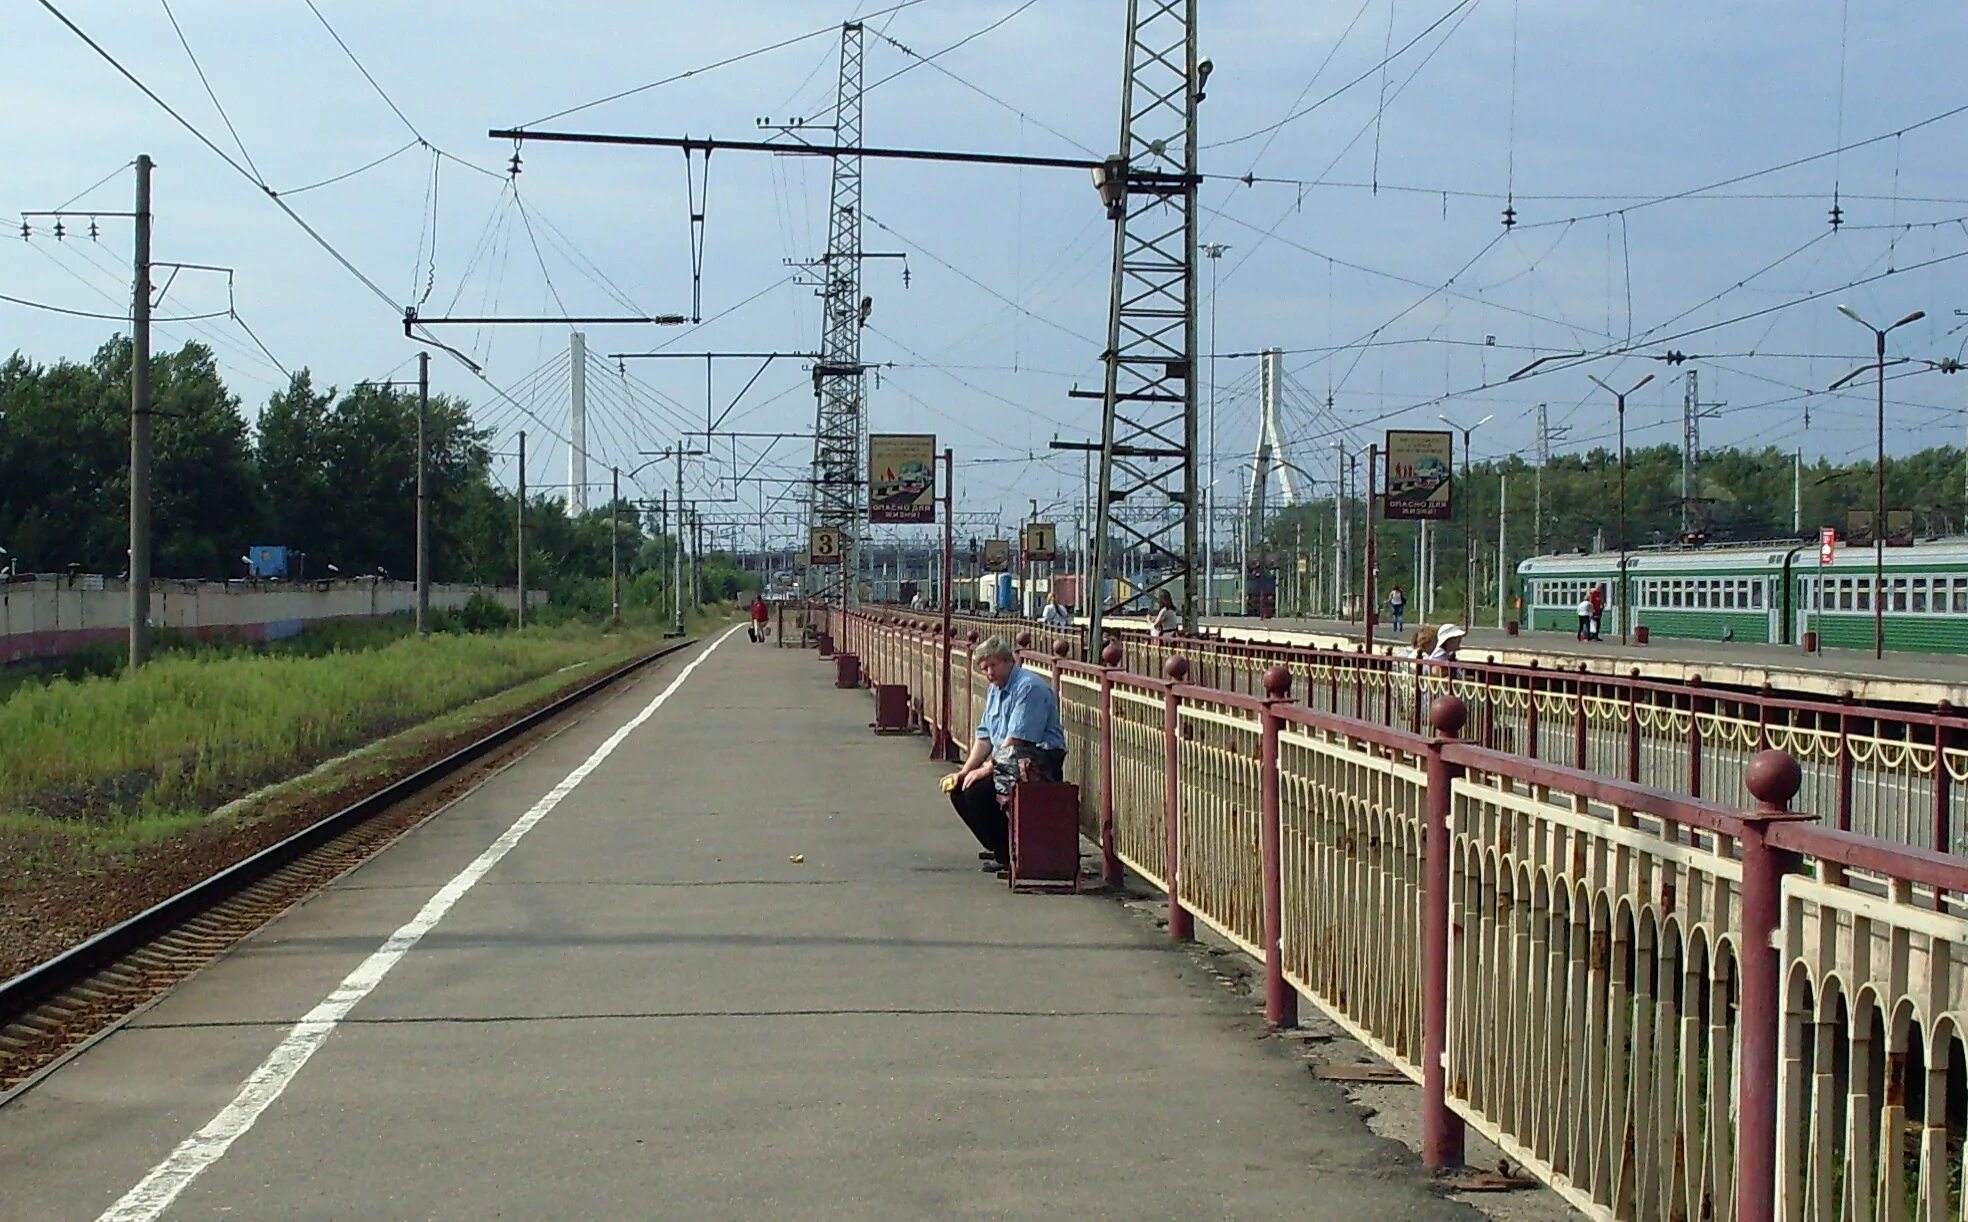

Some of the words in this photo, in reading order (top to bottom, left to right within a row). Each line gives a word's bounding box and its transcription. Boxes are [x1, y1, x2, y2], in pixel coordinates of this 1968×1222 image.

[911, 504, 931, 512] ДЛЯ
[819, 534, 832, 554] 3
[1035, 531, 1046, 550] 1
